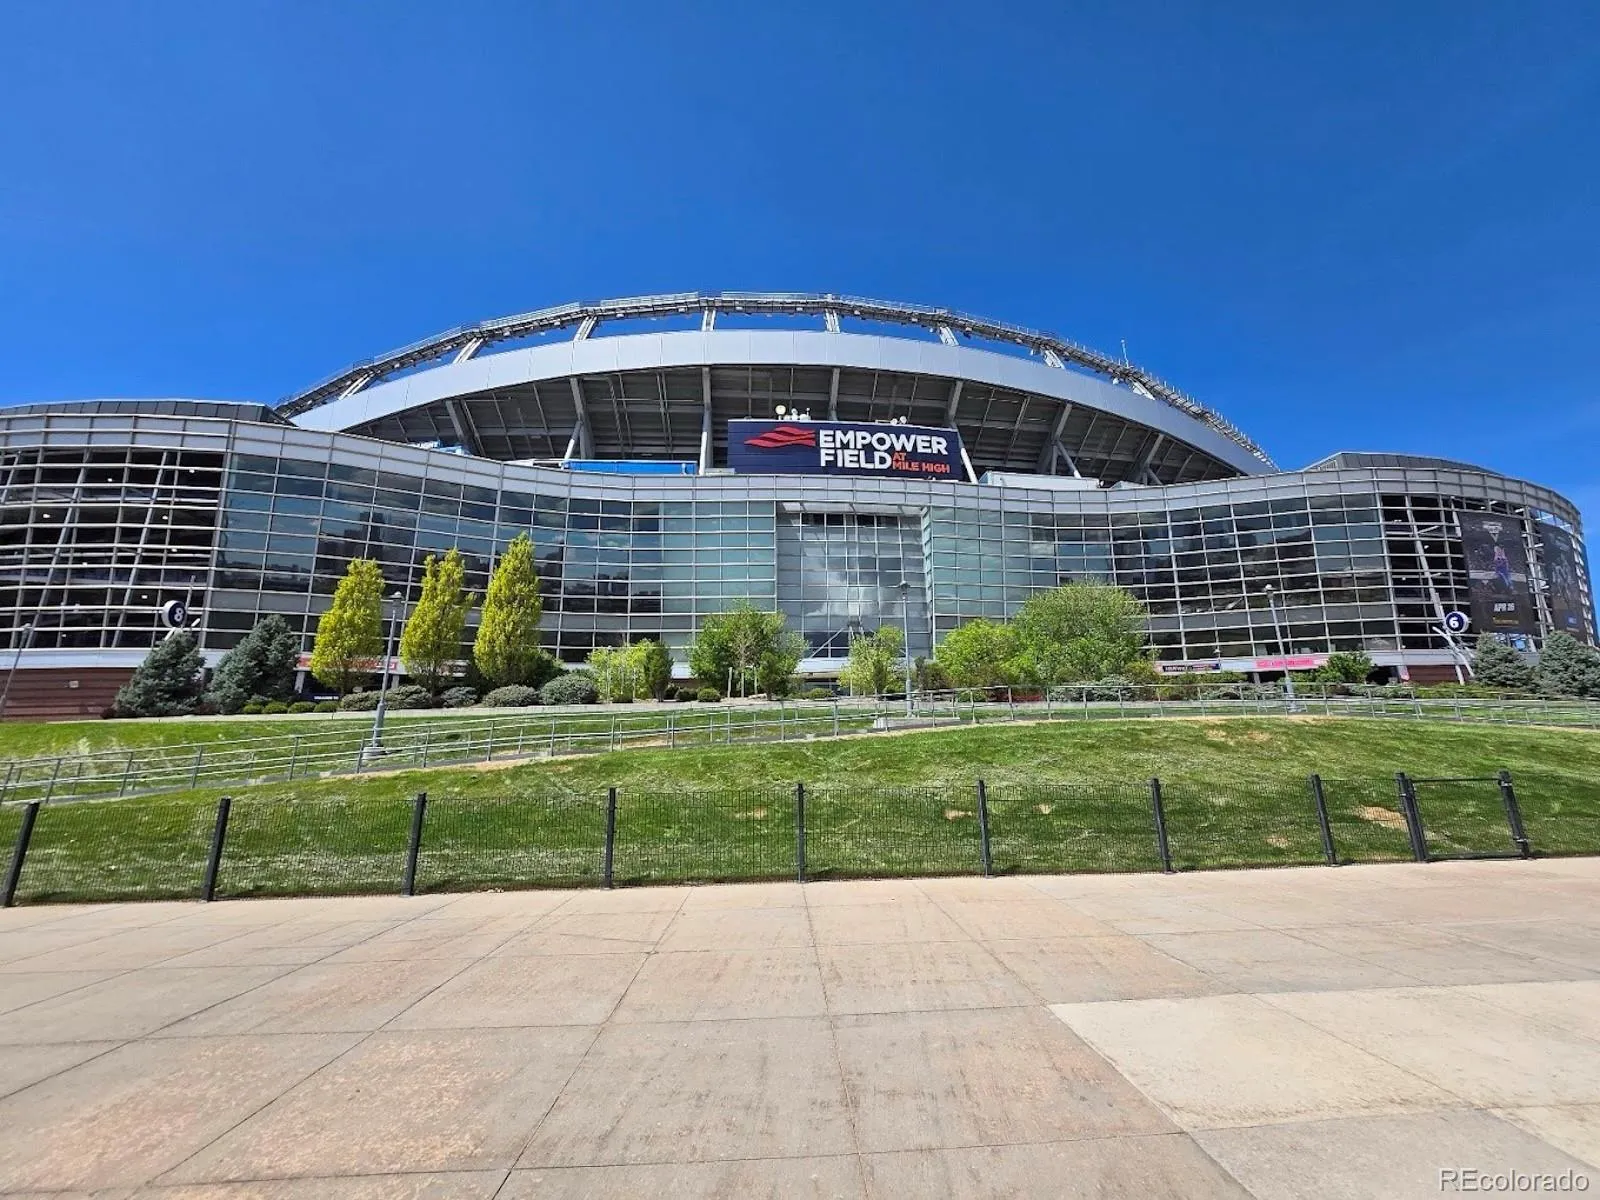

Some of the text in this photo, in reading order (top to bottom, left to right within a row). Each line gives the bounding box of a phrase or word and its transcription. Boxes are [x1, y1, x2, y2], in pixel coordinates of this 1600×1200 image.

[820, 430, 948, 455] EMPOWER
[820, 449, 892, 469] FIELD
[893, 453, 907, 461] AT
[892, 461, 950, 473] MILE HIGH
[173, 607, 185, 622] 8
[1449, 616, 1460, 628] 6
